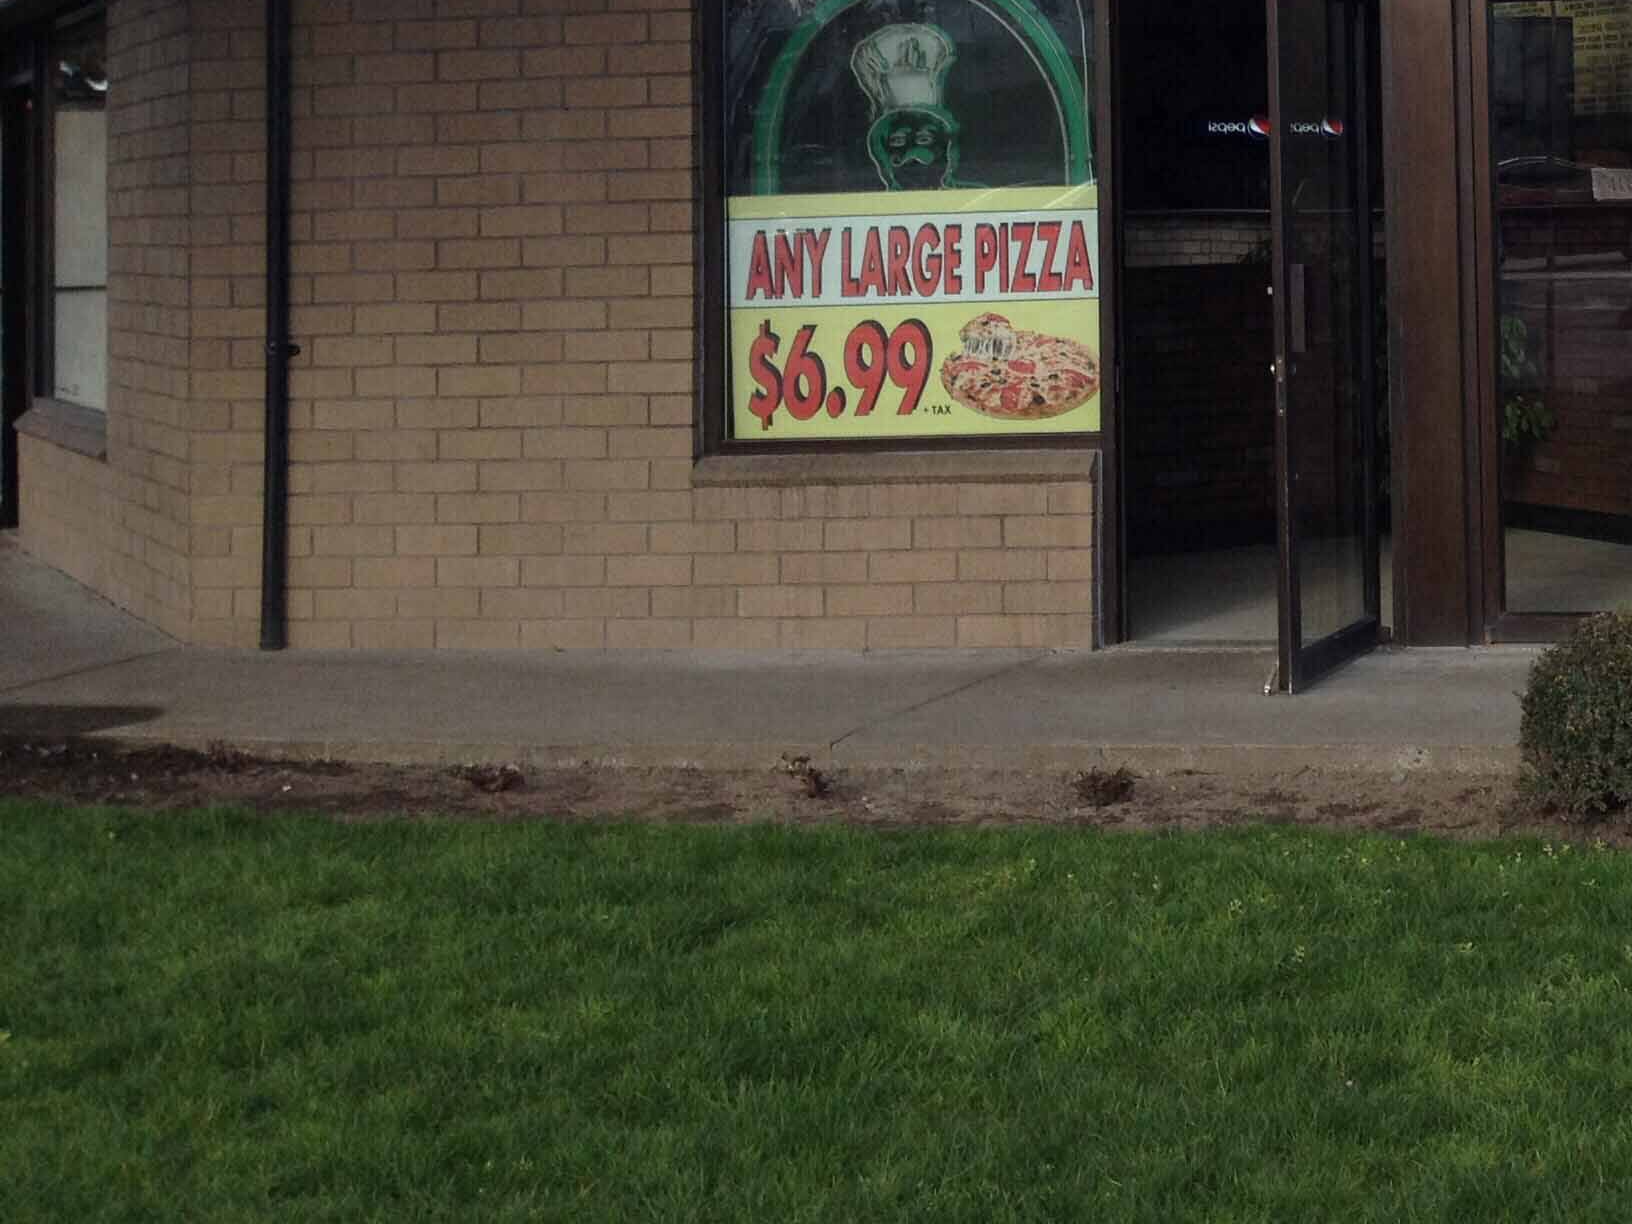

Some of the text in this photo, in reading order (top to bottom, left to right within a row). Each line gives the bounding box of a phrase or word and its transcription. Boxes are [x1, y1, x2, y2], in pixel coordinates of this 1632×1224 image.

[745, 220, 1094, 300] ANY LARGE PIZZA
[748, 318, 932, 430] $6.99
[931, 405, 952, 416] TAX
